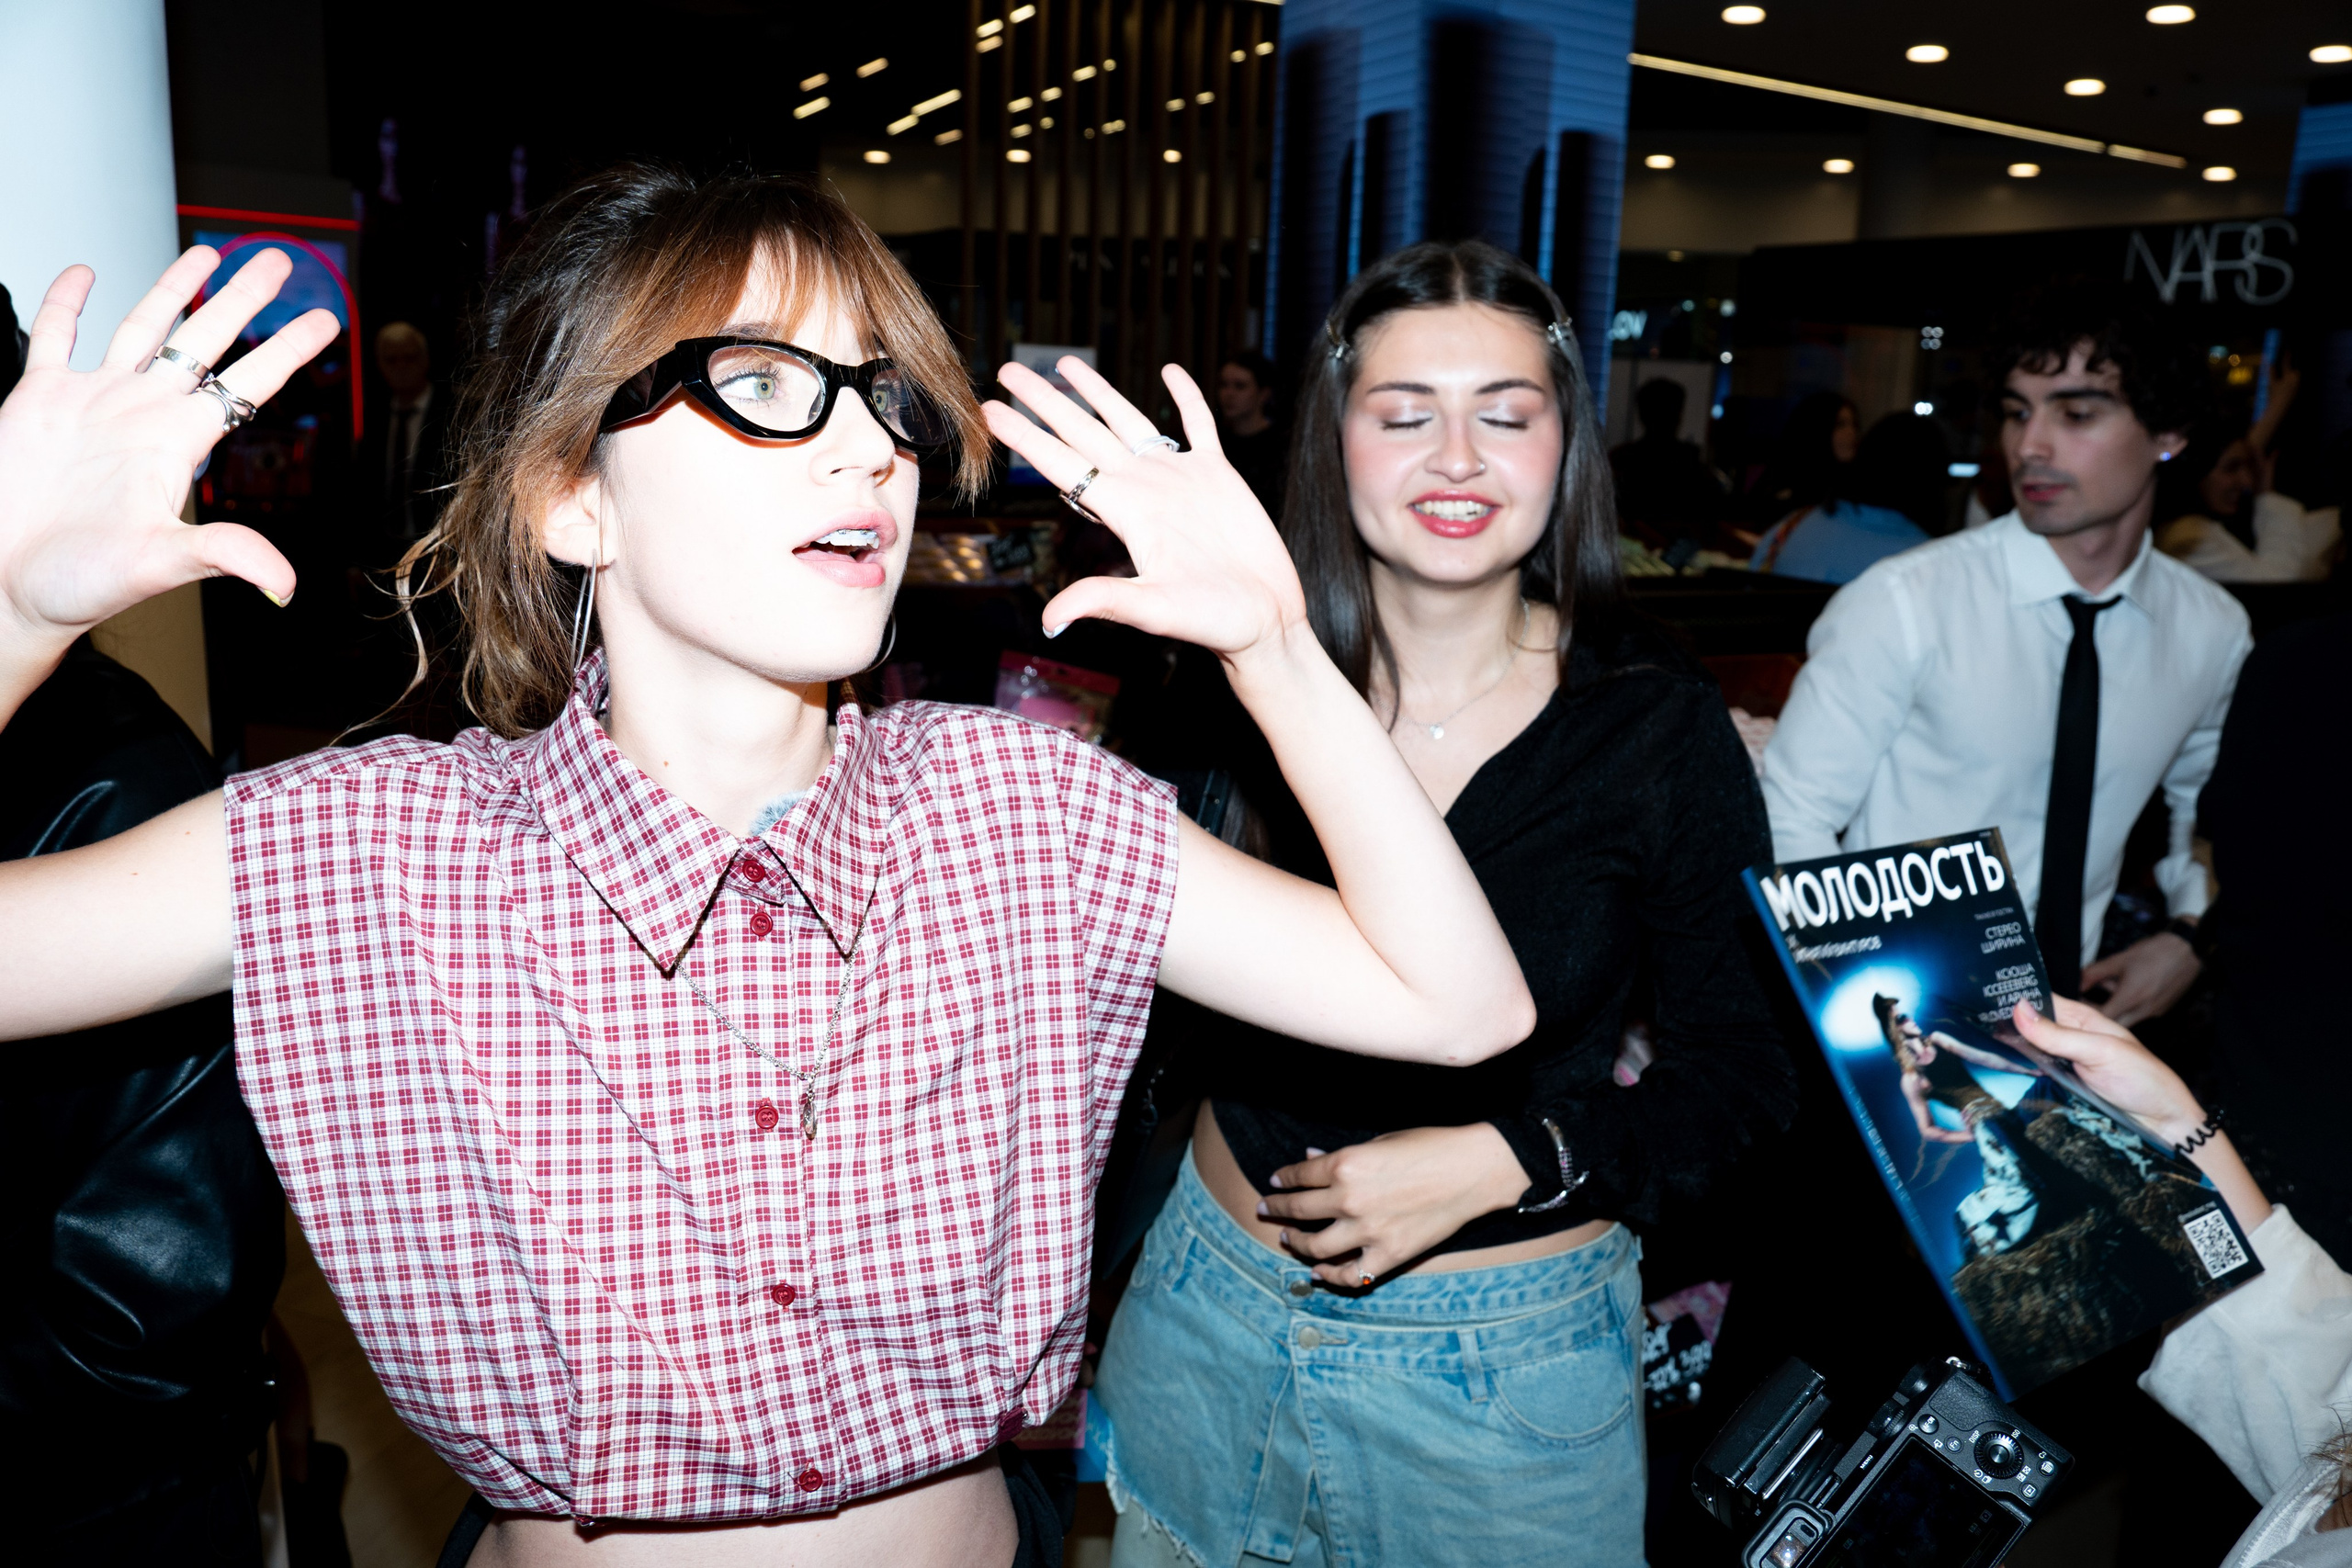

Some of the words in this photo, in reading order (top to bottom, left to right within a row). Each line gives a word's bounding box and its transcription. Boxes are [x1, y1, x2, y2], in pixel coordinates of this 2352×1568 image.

[2124, 218, 2299, 306] NARS
[1759, 840, 2005, 931] МОЛОДОСТЬ
[1984, 921, 2021, 940] СТЕРЕО
[1980, 934, 2026, 954] ШИРИНА
[1969, 1429, 1981, 1444] DISP
[2010, 1428, 2021, 1438] ISO
[1950, 1439, 1960, 1450] Fn
[1860, 1454, 1873, 1470] MENU
